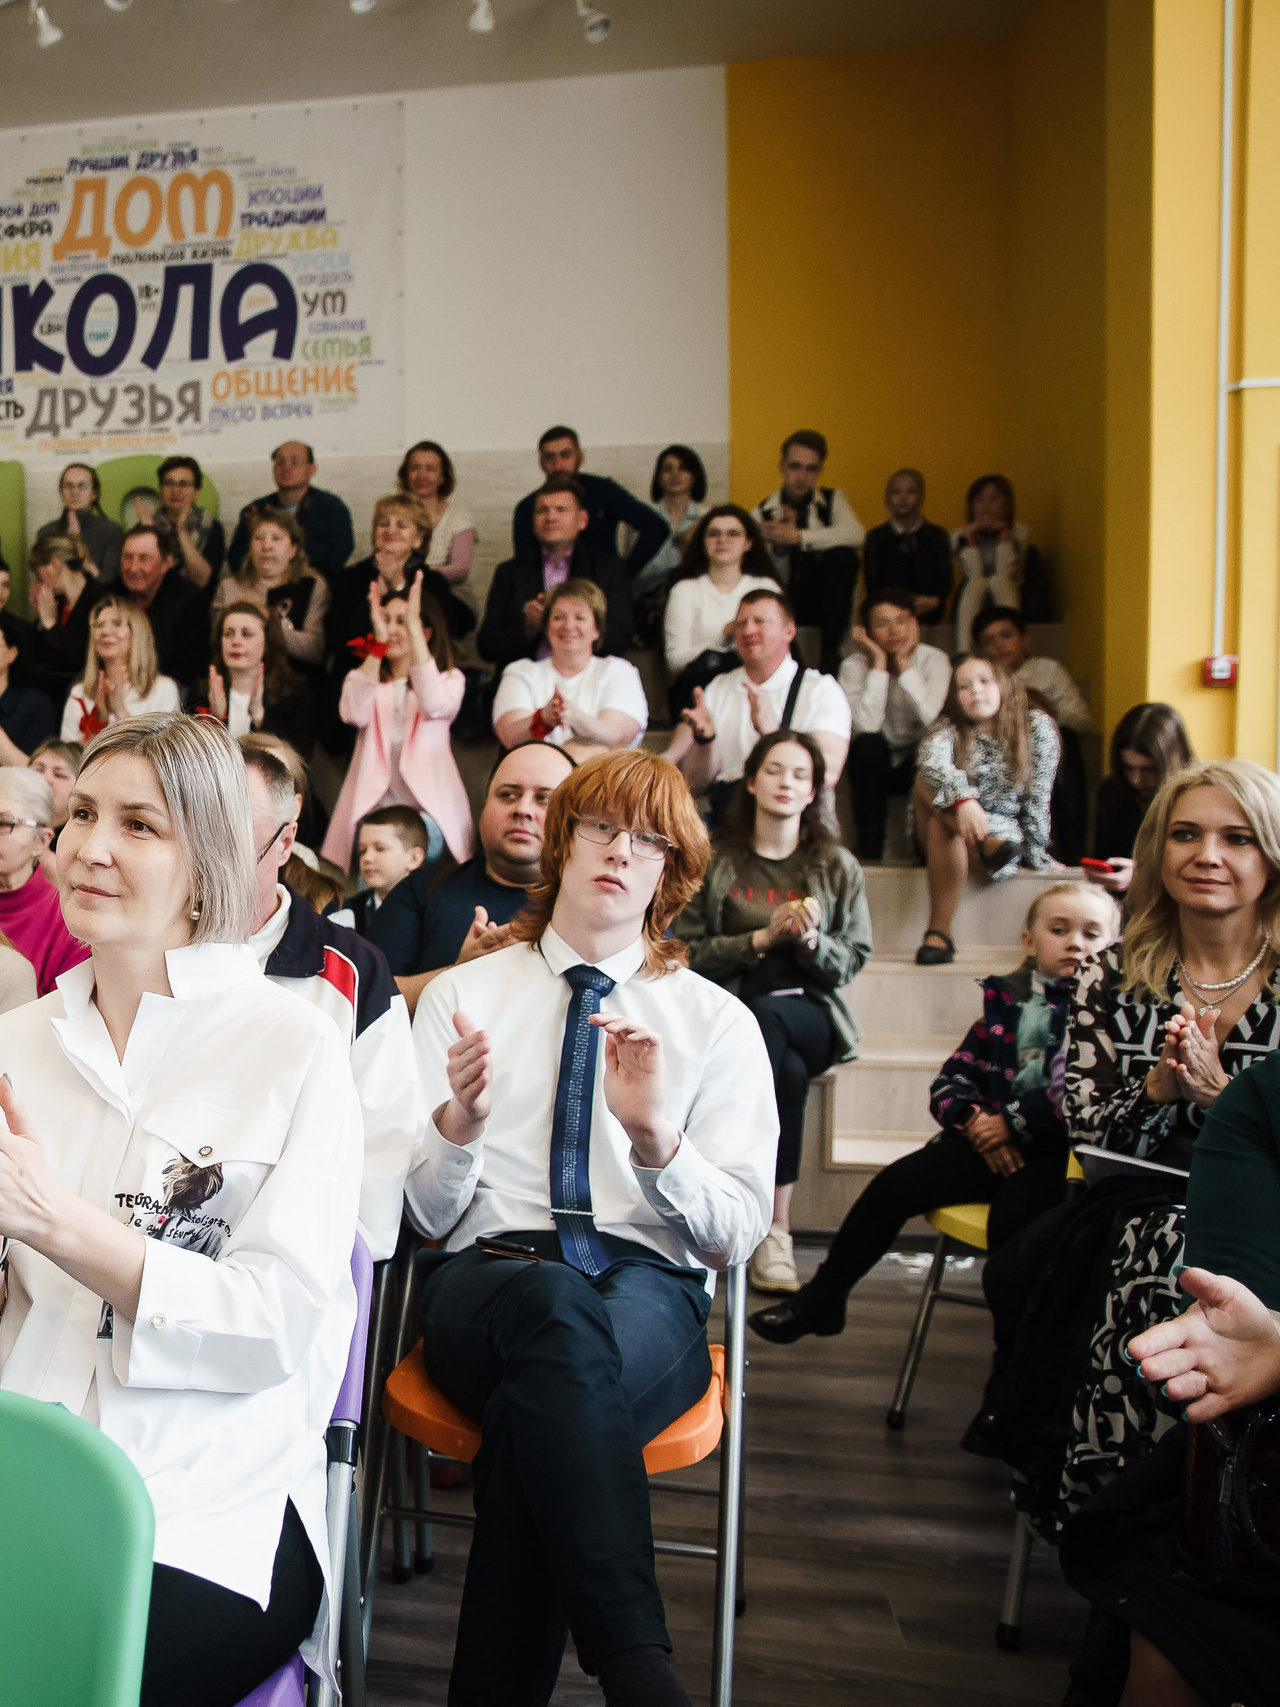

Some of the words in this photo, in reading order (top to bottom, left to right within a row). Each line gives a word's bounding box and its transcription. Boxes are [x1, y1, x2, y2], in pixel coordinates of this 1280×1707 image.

[29, 200, 60, 217] ДОМ
[53, 169, 234, 261] ДОМ
[240, 206, 327, 228] ТРАДИЦИИ
[233, 226, 339, 260] ДРУЖБА
[301, 290, 347, 318] УМ
[301, 335, 372, 362] СЕМЬЯ
[210, 363, 358, 401] ОБЩЕНИЕ
[25, 380, 202, 439] ДРУЗЬЯ
